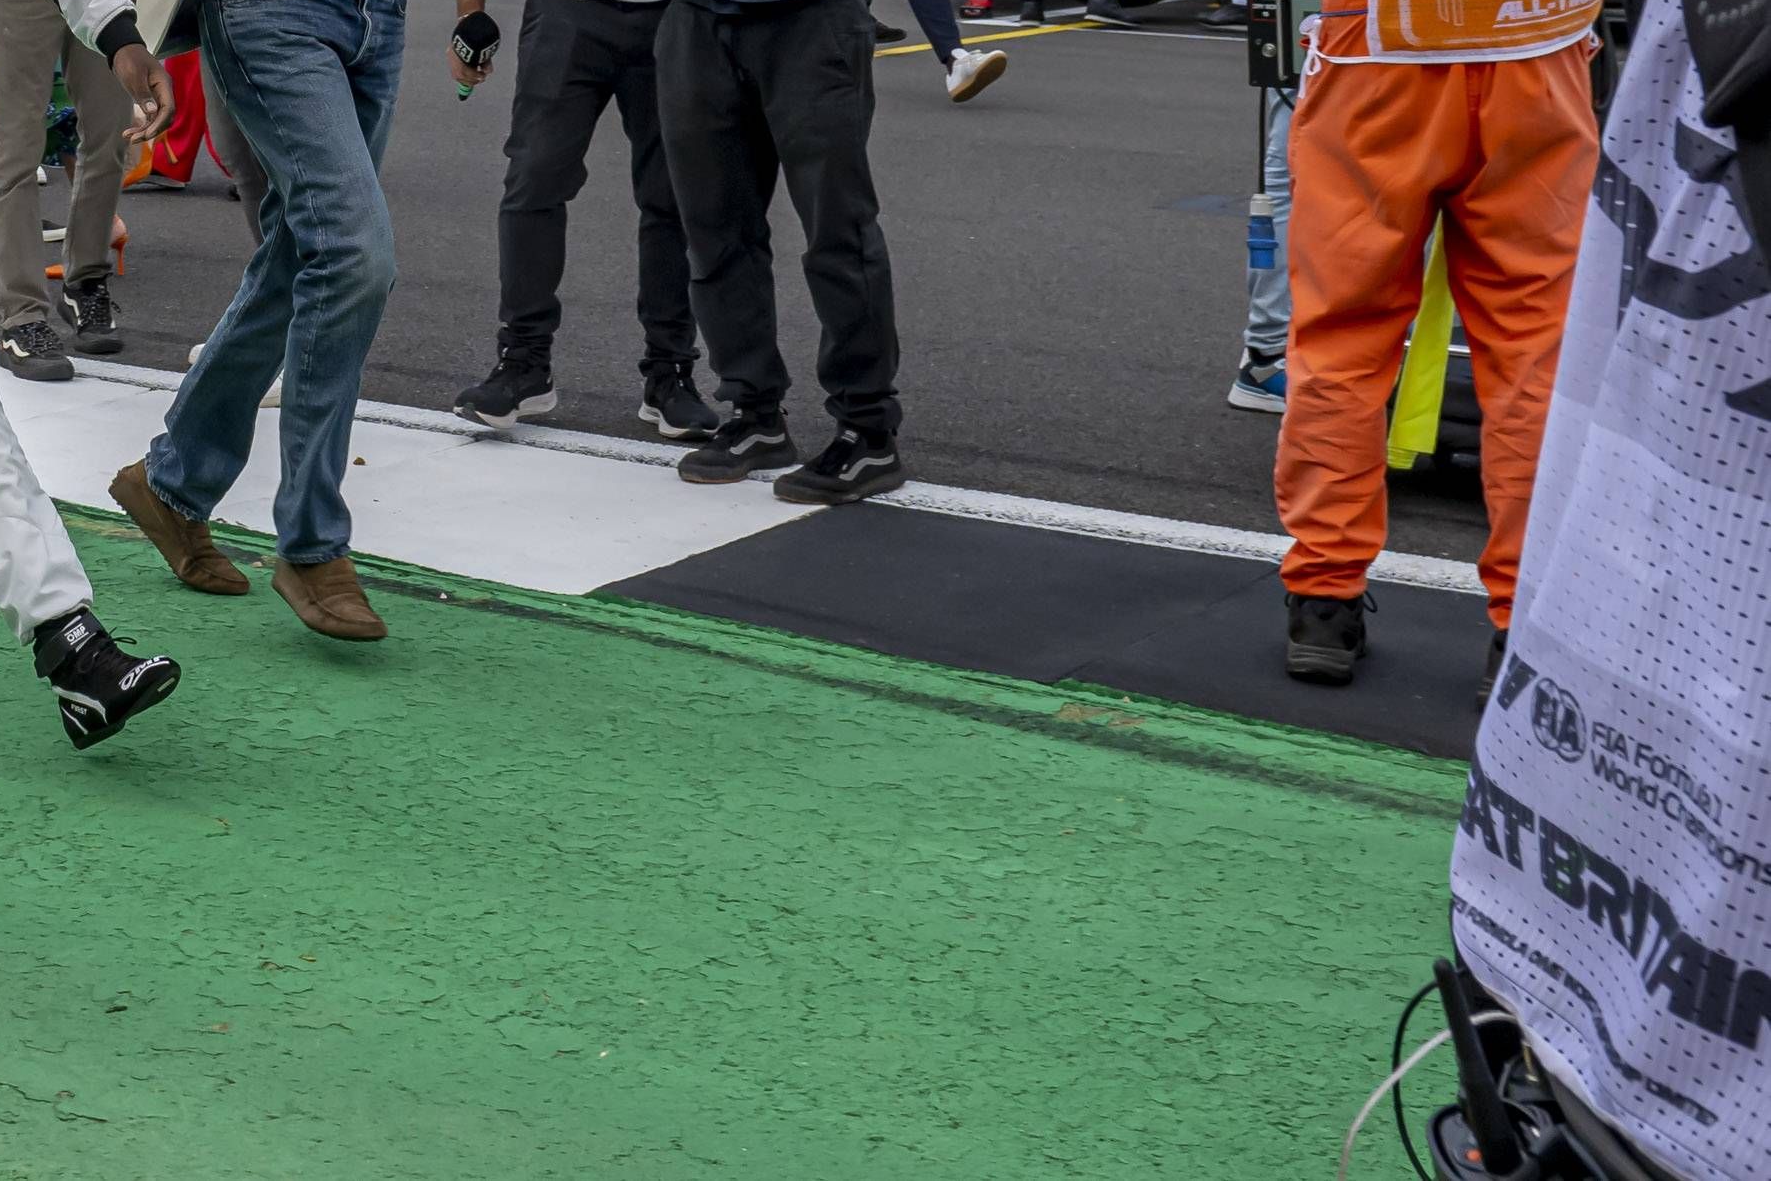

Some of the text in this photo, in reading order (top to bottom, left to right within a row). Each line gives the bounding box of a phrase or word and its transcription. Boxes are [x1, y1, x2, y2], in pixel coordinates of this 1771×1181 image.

[67, 626, 86, 642] OMP
[1591, 721, 1630, 762] FIA
[1590, 749, 1659, 810] World
